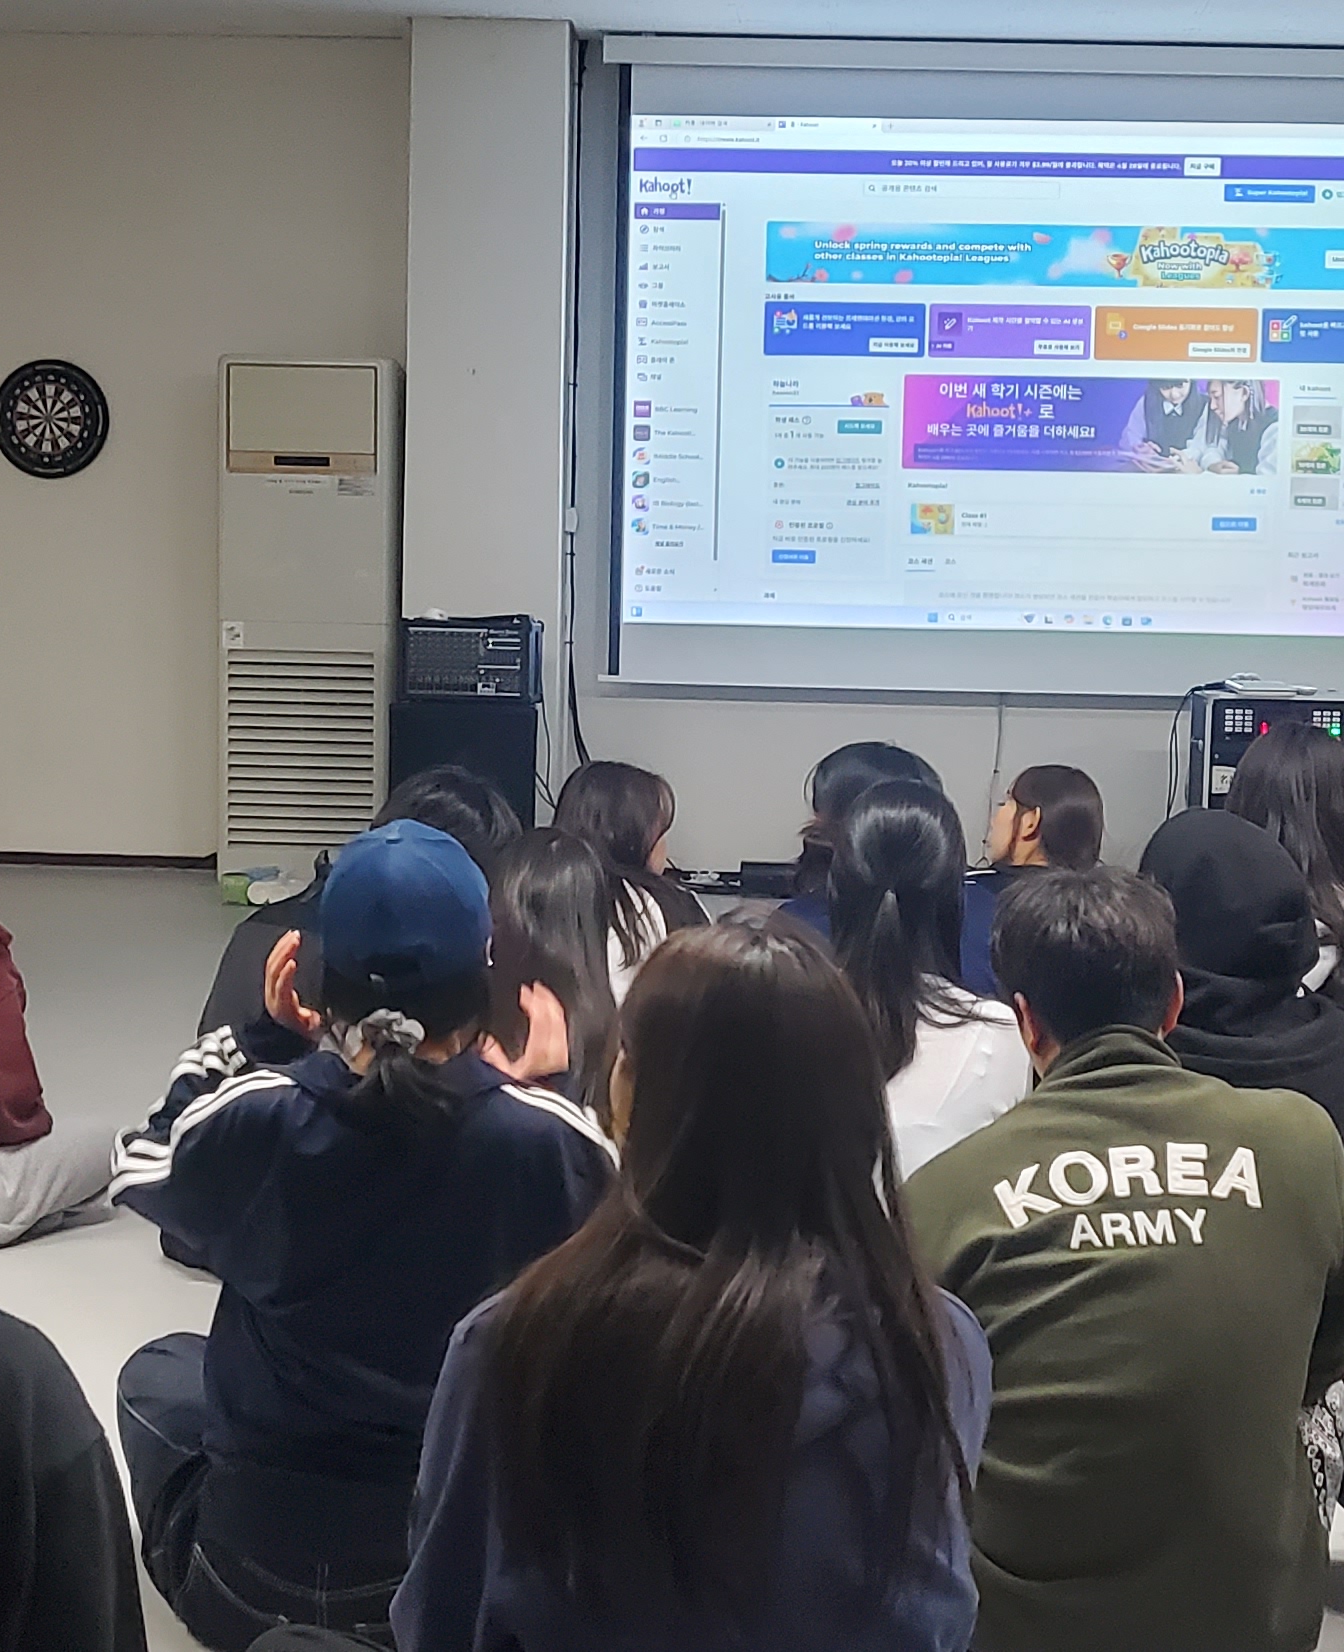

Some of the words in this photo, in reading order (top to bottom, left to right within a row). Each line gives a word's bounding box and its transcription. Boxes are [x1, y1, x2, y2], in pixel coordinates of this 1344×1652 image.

[639, 176, 692, 195] Kahoot!
[814, 241, 850, 250] Unlock
[854, 241, 887, 252] spring
[890, 242, 933, 251] rewards
[935, 242, 955, 251] and
[958, 243, 1005, 253] compete
[1007, 242, 1032, 251] with
[1140, 239, 1230, 266] Kahootopia
[846, 252, 884, 261] classes
[886, 252, 896, 261] in
[965, 254, 1010, 264] Leagues
[1181, 262, 1203, 271] with
[939, 382, 968, 399] 이번
[972, 382, 987, 399] 새
[991, 383, 1020, 399] 학기
[1023, 383, 1083, 400] 시즌에는
[1038, 404, 1055, 419] 로
[927, 423, 963, 437] 배우는
[966, 424, 990, 437] 곳에
[993, 424, 1040, 438] 즐거움을
[1043, 425, 1095, 439] 더하세요!
[993, 1142, 1262, 1229] KOREA
[1070, 1208, 1207, 1249] ARMY
